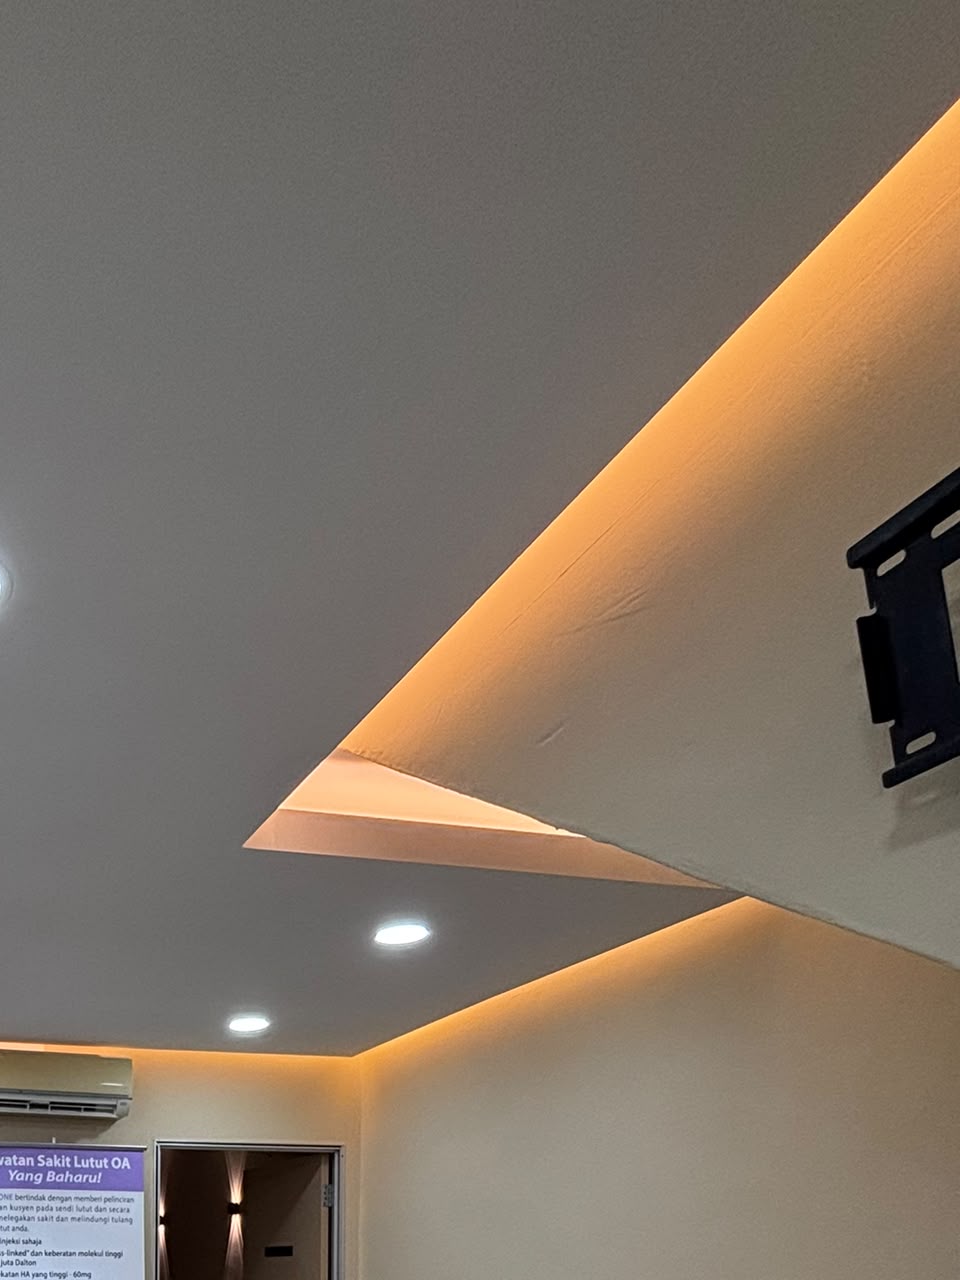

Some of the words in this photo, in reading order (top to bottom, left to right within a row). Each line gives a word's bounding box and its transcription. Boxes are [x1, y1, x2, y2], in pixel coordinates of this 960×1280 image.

[37, 1154, 71, 1168] Sakit
[74, 1156, 108, 1169] Lutut
[111, 1157, 131, 1169] OA
[8, 1170, 42, 1183] Yang
[46, 1171, 102, 1183] Baharu!
[48, 1195, 72, 1204] dengan
[104, 1196, 134, 1204] pelinciran
[10, 1205, 34, 1214] kusyen
[36, 1205, 53, 1214] pada
[71, 1216, 110, 1224] melindungi
[111, 1216, 133, 1225] tulang
[0, 1238, 20, 1246] injeksi
[22, 1238, 42, 1247] sahaja
[105, 1251, 123, 1259] tinggi
[49, 1271, 68, 1280] tinggi
[73, 1271, 91, 1280] 60mg
